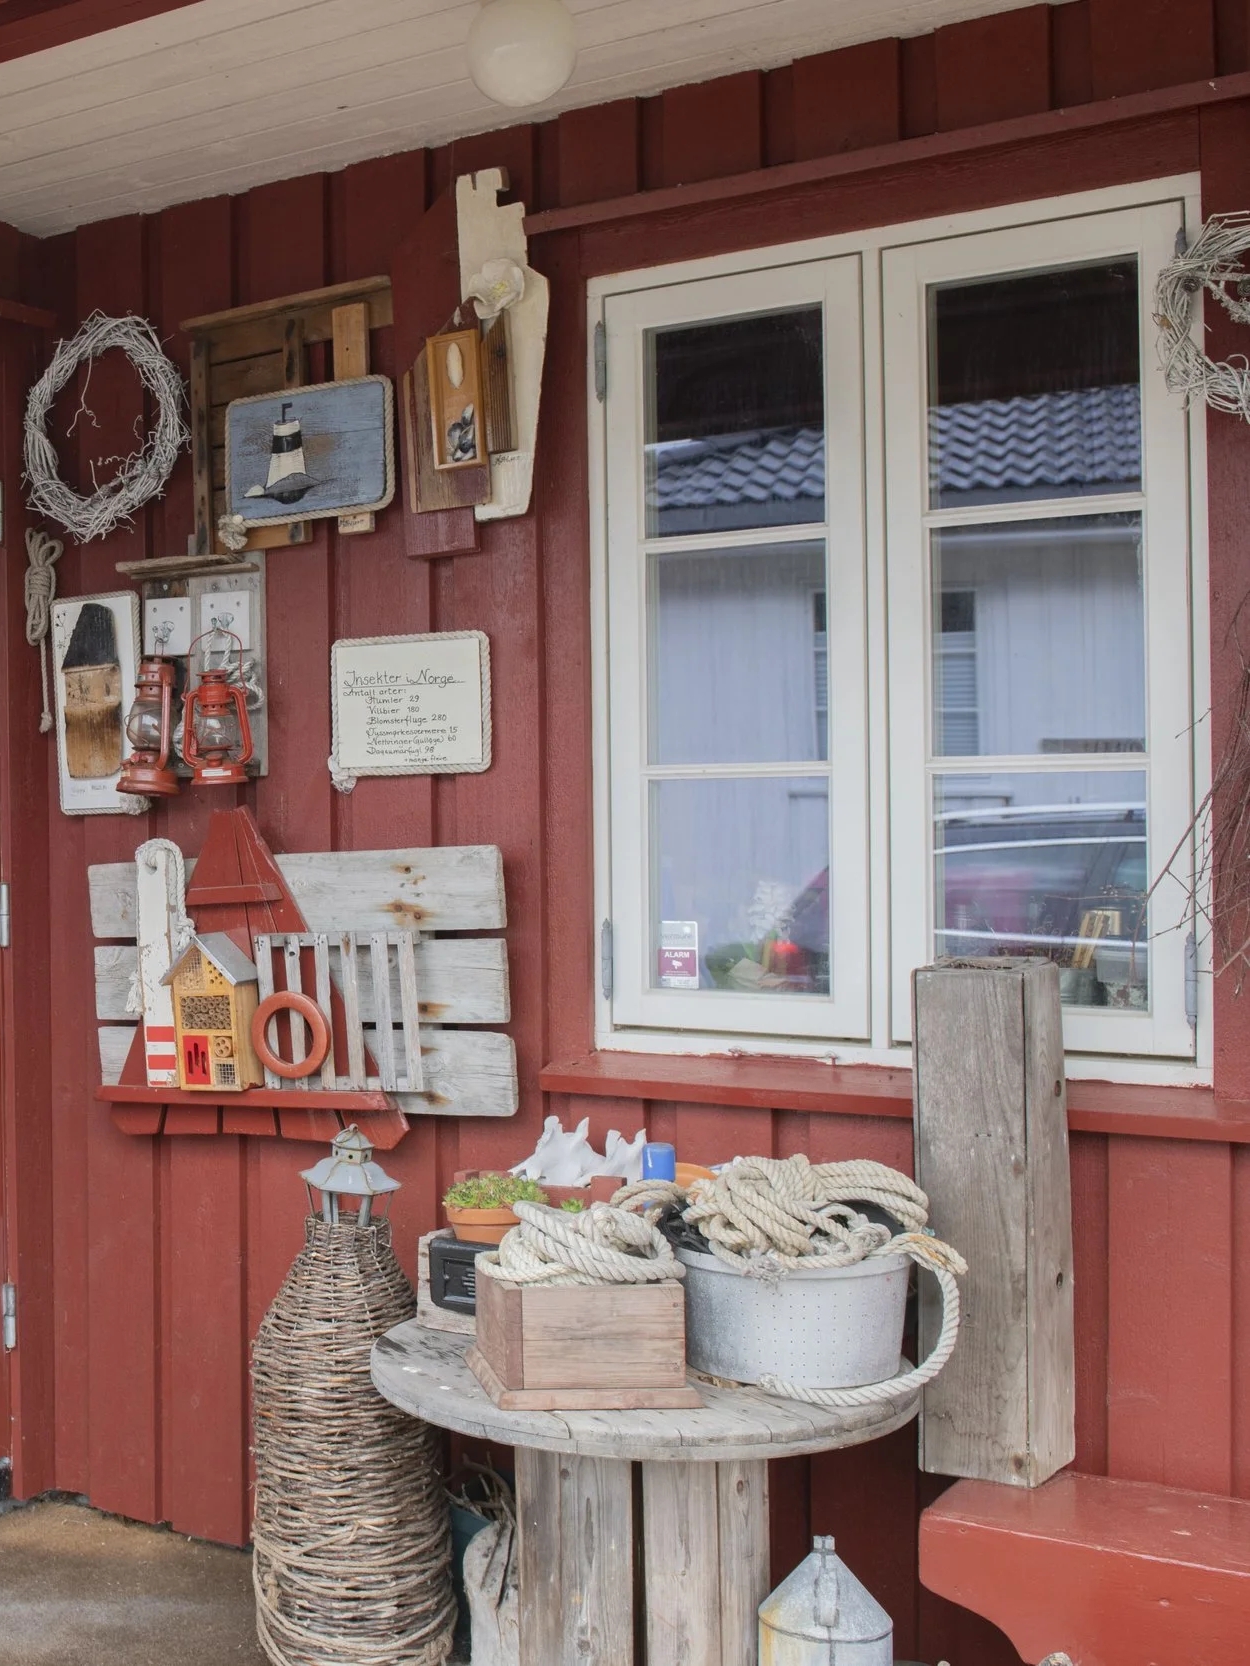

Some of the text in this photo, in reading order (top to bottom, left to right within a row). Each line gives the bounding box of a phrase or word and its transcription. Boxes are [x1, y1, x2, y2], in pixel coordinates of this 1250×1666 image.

[343, 670, 401, 687] Insekter
[409, 694, 420, 702] 29
[431, 713, 447, 721] 280
[424, 745, 435, 754] 98
